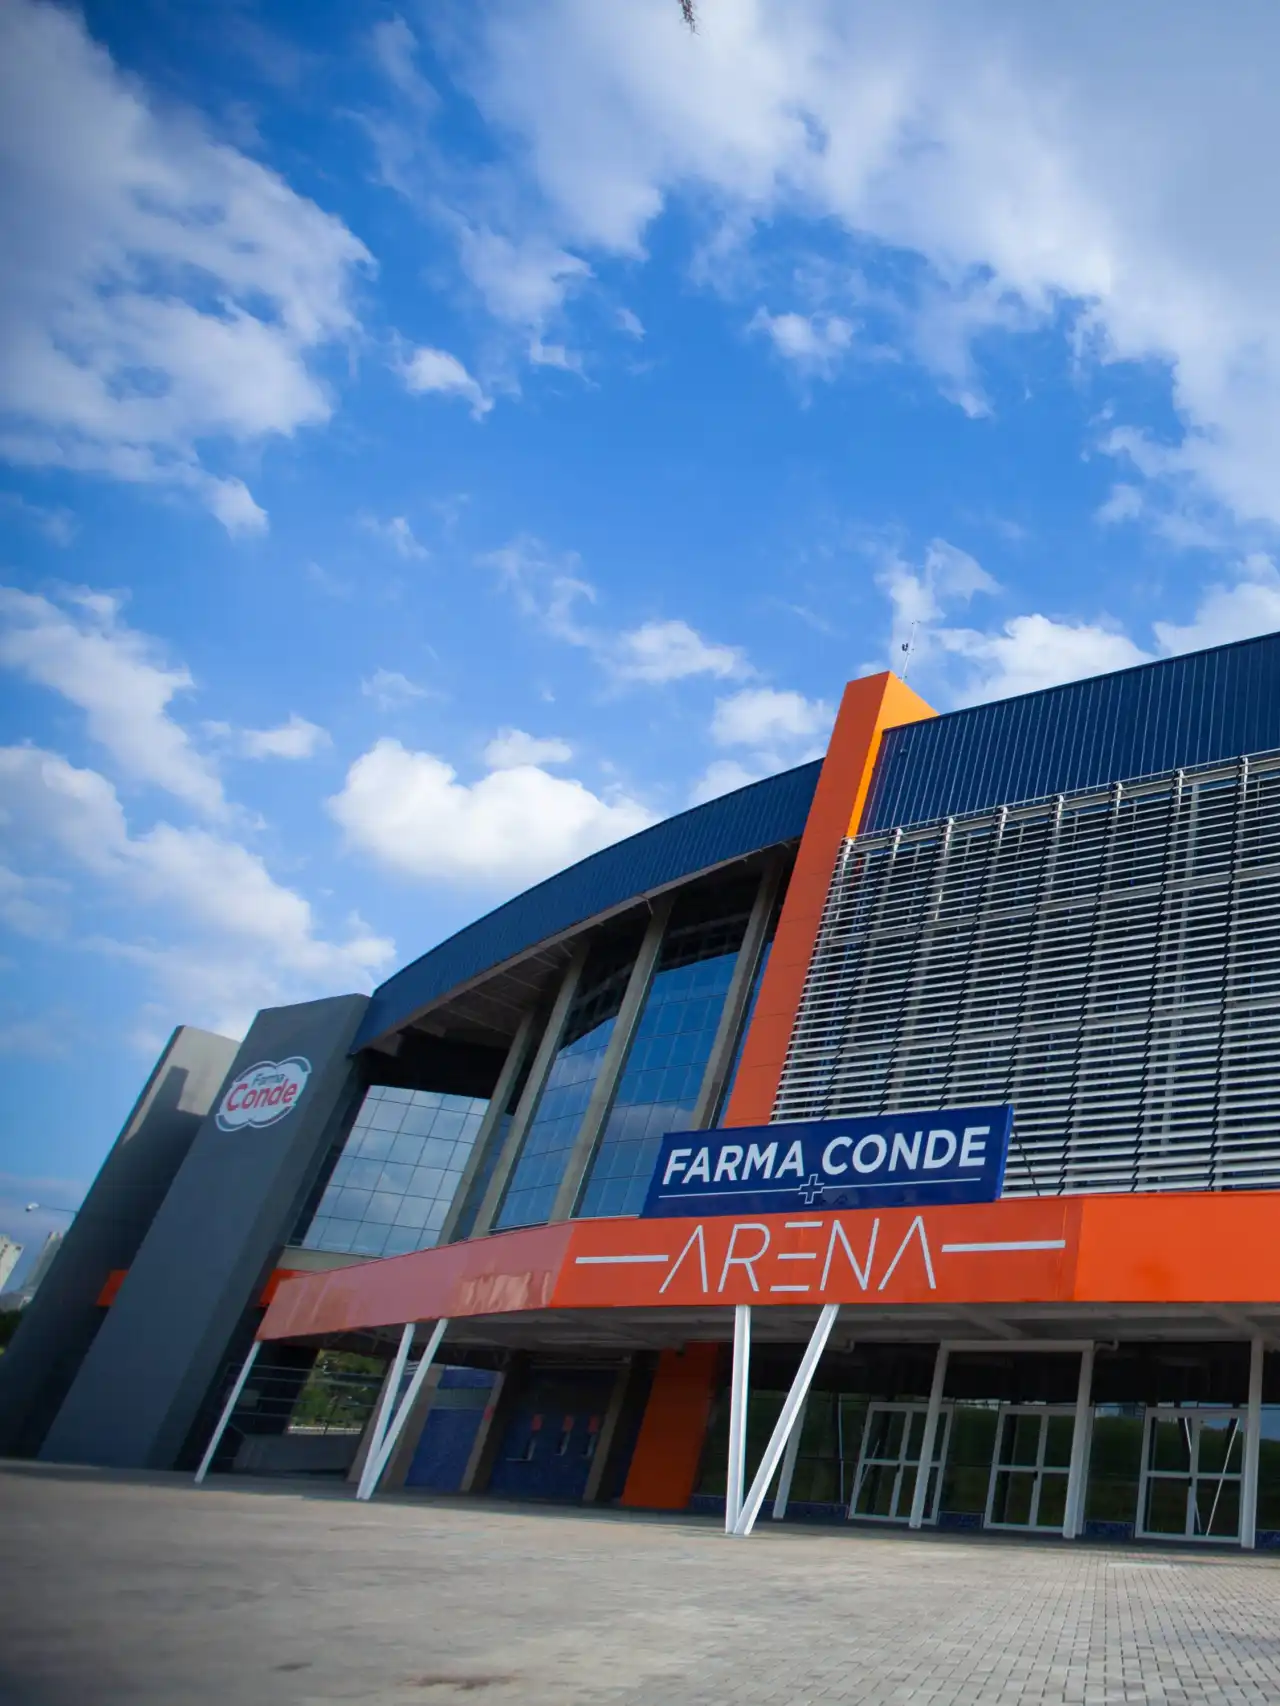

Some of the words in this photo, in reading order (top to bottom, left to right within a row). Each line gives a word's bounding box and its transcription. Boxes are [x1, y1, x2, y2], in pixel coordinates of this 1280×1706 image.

[227, 1080, 297, 1111] Conde
[662, 1140, 804, 1185] FARMA
[822, 1126, 990, 1175] CONDE
[659, 1215, 937, 1293] ARENA
